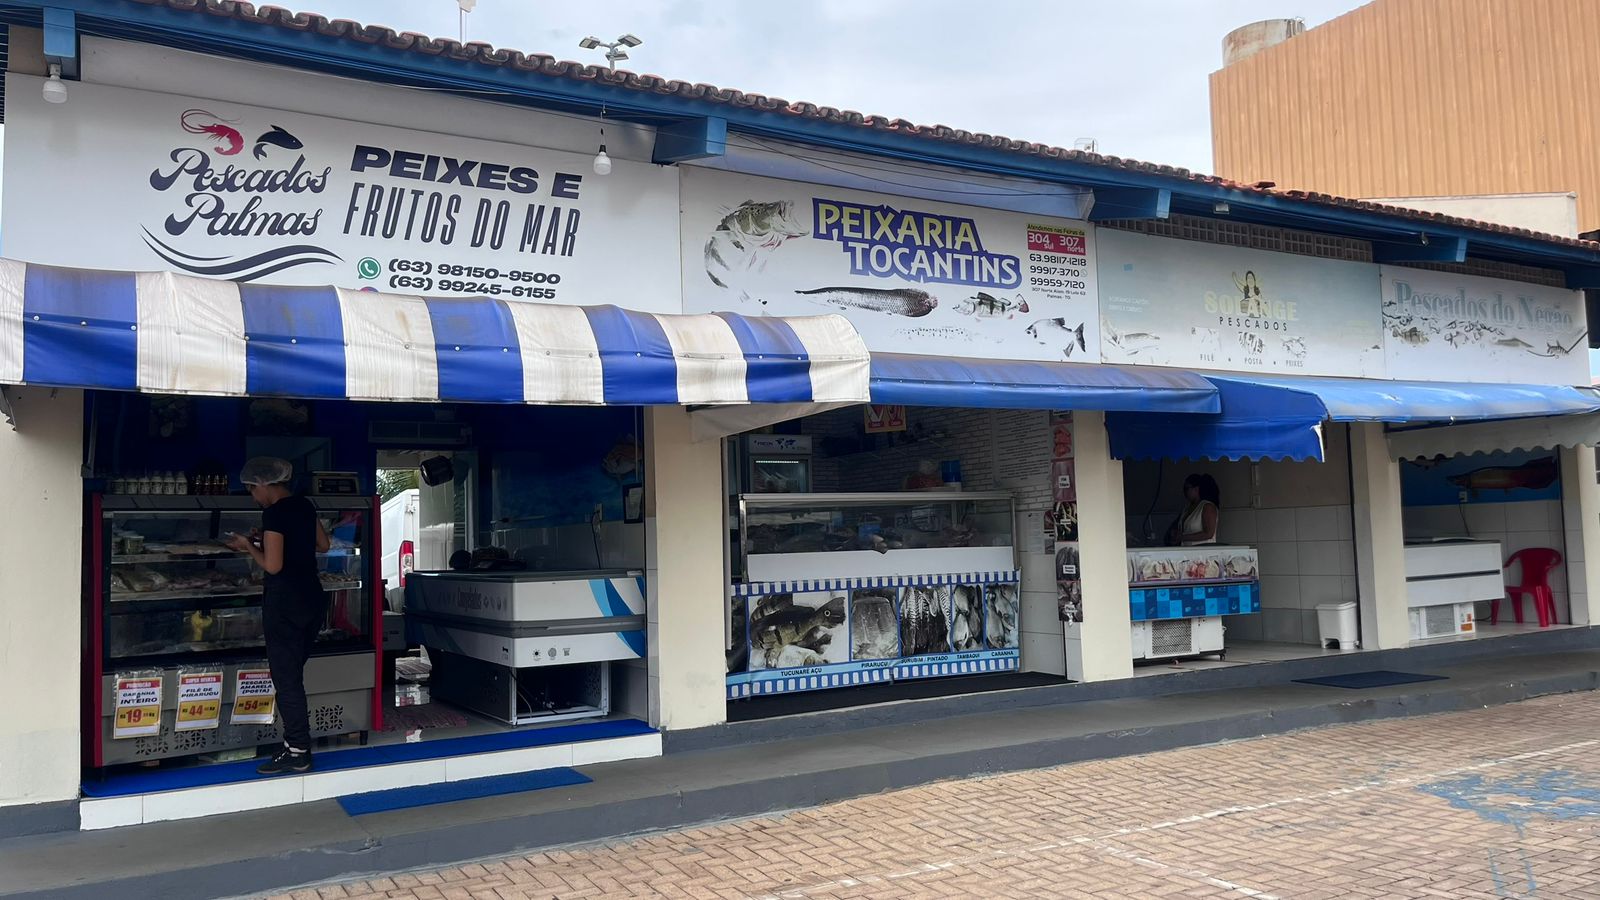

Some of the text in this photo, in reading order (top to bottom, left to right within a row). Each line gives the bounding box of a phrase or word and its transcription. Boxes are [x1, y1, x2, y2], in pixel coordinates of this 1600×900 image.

[150, 147, 332, 193] Pescados
[350, 144, 583, 200] PEIXES E
[164, 192, 323, 236] Palmas
[342, 181, 581, 257] FRUTOS DO MAR
[818, 203, 980, 252] PEIXARIA
[1028, 232, 1080, 247] 304 307
[1044, 242, 1084, 253] sul norte
[848, 242, 1018, 285] TOCANTINS
[1029, 253, 1087, 266] 63.98117-1218
[388, 258, 561, 285] (63) 98150-9500
[1029, 265, 1080, 277] 99917-3710
[389, 274, 556, 299] (63) 99245-6155
[1030, 277, 1085, 289] 99959-7120
[1203, 290, 1299, 321] SOLANGE
[1391, 279, 1489, 318] Pescados
[1491, 293, 1515, 326] do
[1219, 316, 1287, 331] PESCADOS
[1244, 357, 1263, 365] POSTA
[1285, 360, 1304, 368] PEIXES
[810, 667, 823, 675] AÇU
[120, 697, 158, 705] INTEIRO
[244, 700, 259, 711] 54
[126, 708, 142, 723] 19
[189, 704, 203, 716] 44
